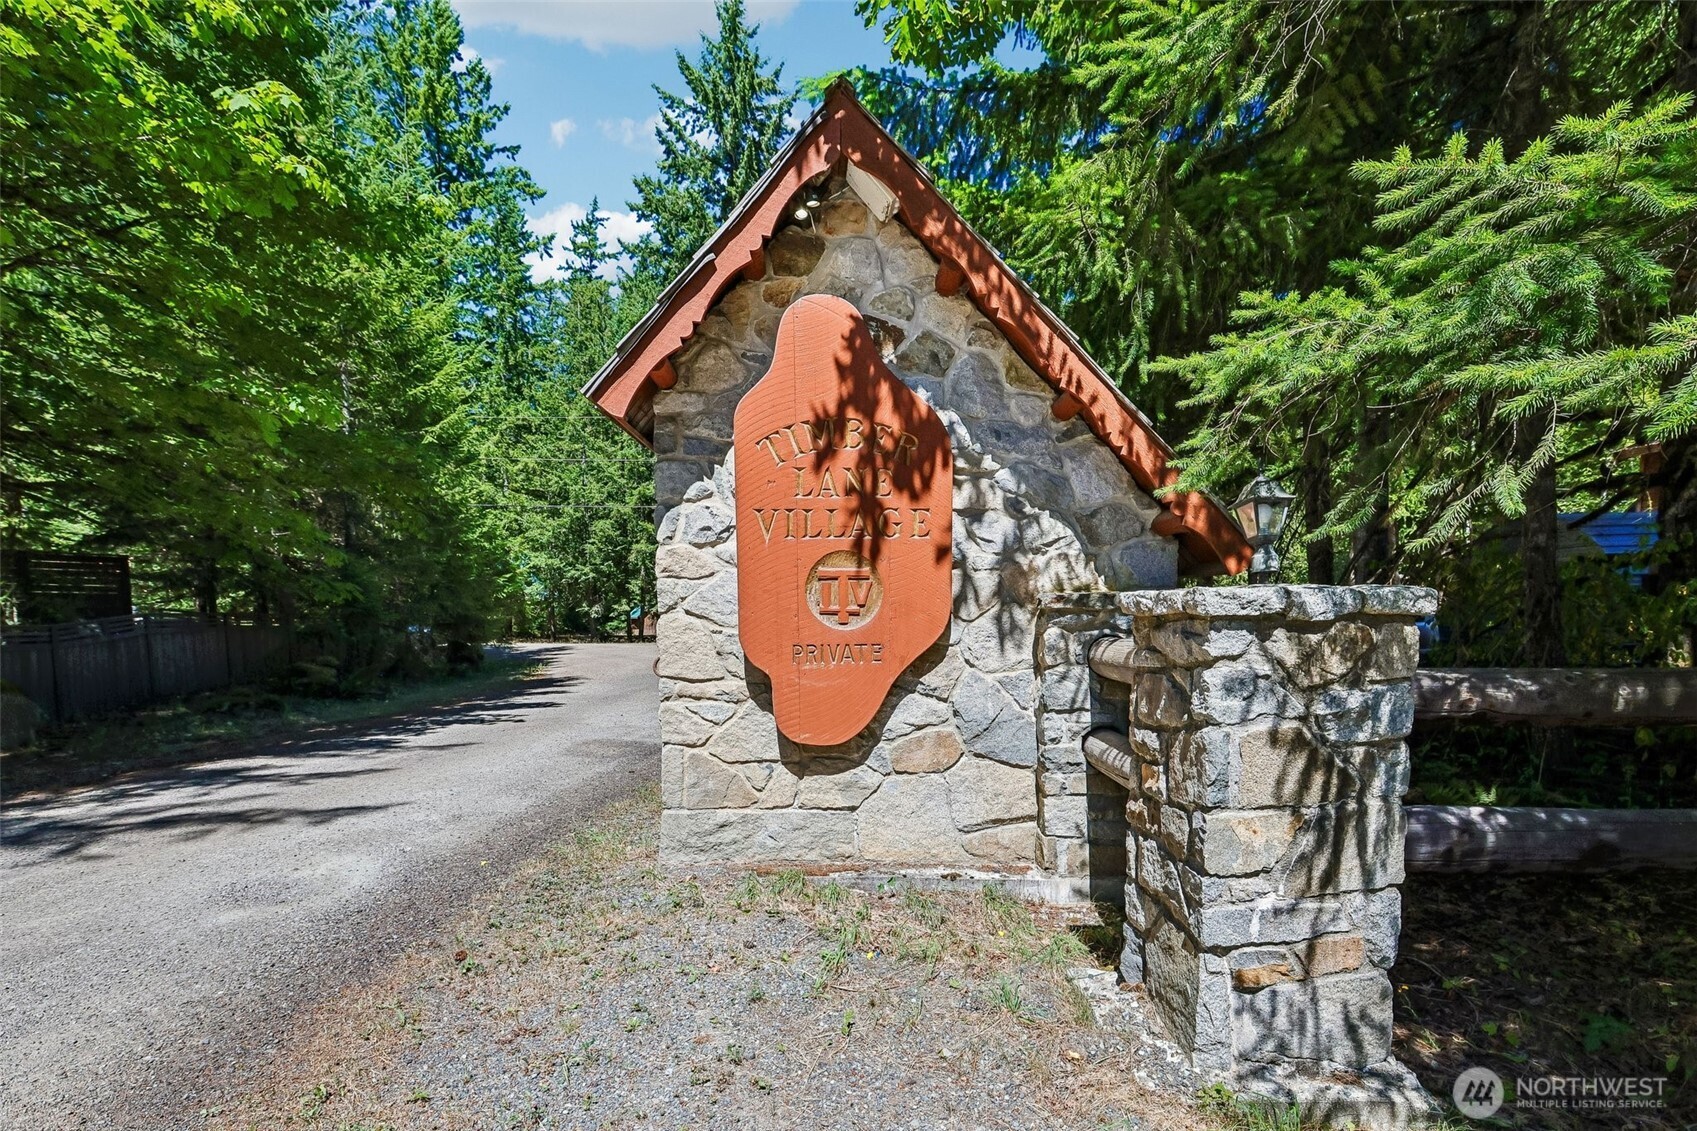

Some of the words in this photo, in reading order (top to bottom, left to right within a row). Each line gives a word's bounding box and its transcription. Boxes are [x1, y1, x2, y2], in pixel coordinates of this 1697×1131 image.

[755, 418, 919, 468] TIMBER
[792, 465, 893, 499] LANE
[752, 507, 932, 545] VILLAGE
[791, 643, 884, 666] PRIVATE
